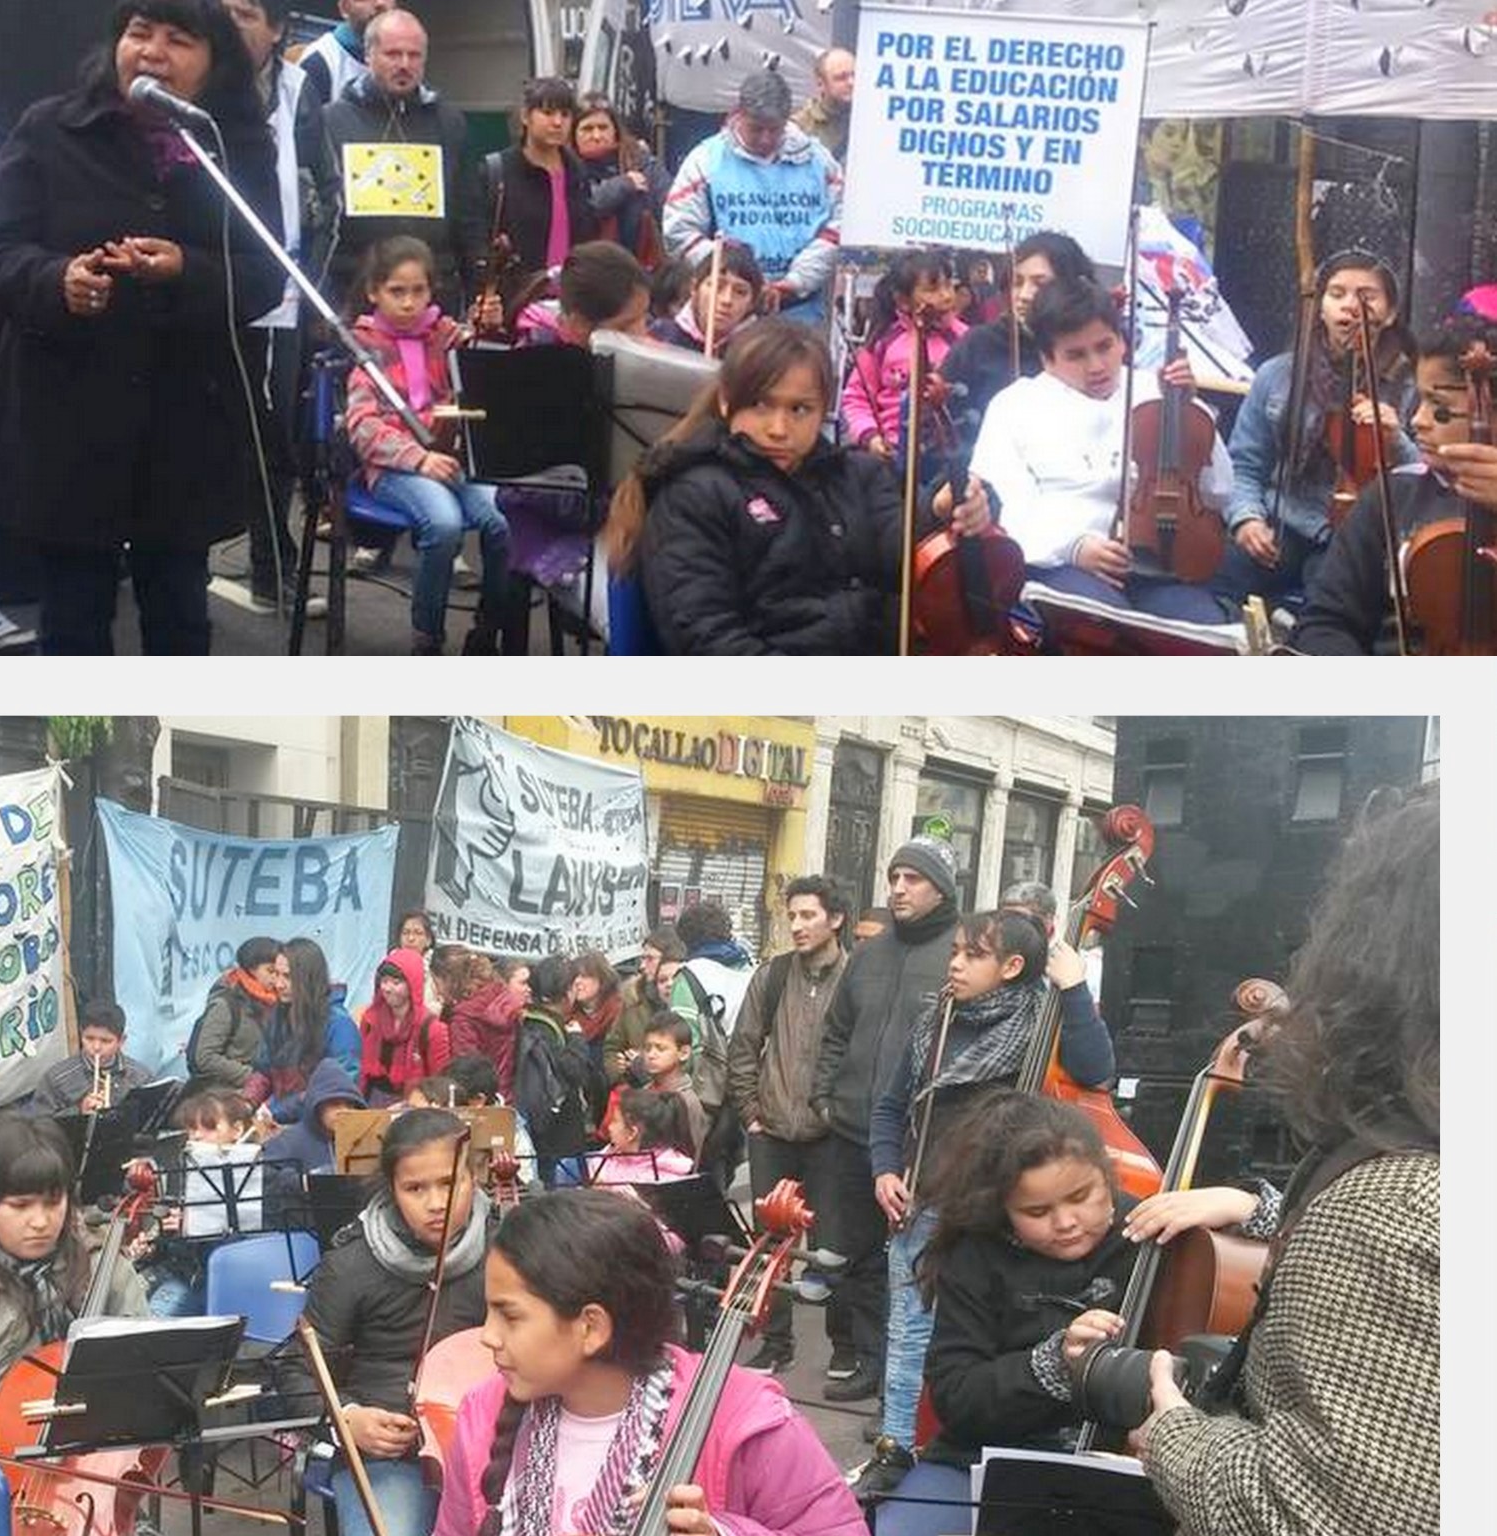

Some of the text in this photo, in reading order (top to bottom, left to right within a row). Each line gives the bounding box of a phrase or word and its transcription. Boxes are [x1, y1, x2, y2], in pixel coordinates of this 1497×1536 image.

[877, 32, 1125, 71] POR EL DERECHO
[875, 64, 895, 88] A
[905, 66, 940, 92] LA
[887, 96, 1100, 134] POR SALARIOS
[899, 128, 1082, 164] DIGNOS Y EN
[921, 196, 1044, 222] PROGRAMAS
[516, 765, 593, 833] SUTEBA
[169, 841, 362, 921] SUTEBA
[457, 917, 543, 954] DEFENSA
